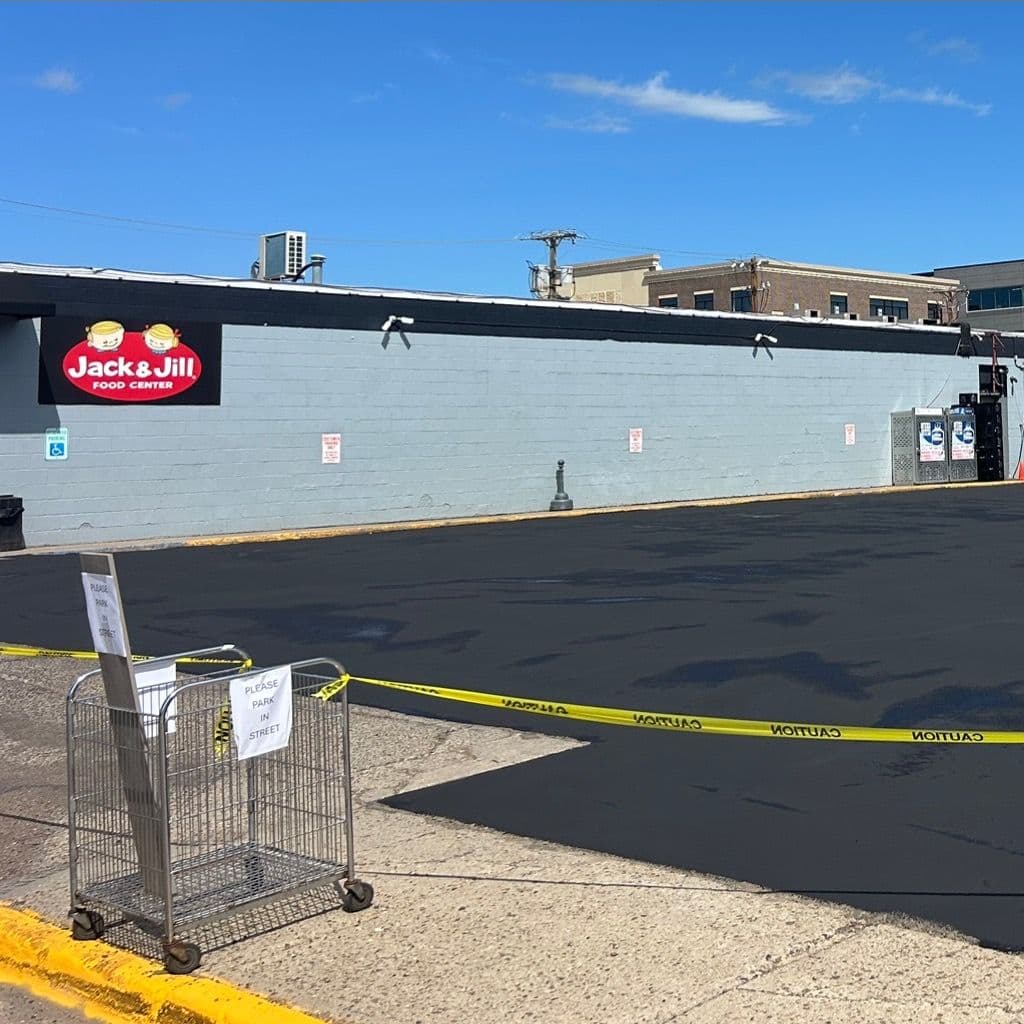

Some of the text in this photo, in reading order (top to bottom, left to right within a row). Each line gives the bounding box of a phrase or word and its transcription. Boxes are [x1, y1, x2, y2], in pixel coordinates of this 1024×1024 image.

[68, 355, 194, 378] Jack & Jill
[92, 381, 173, 390] FOOD CENTER
[90, 583, 109, 592] PLEASE
[245, 680, 279, 695] PLEASE
[252, 696, 275, 709] PARK
[260, 712, 270, 722] IN
[249, 724, 280, 740] STREET
